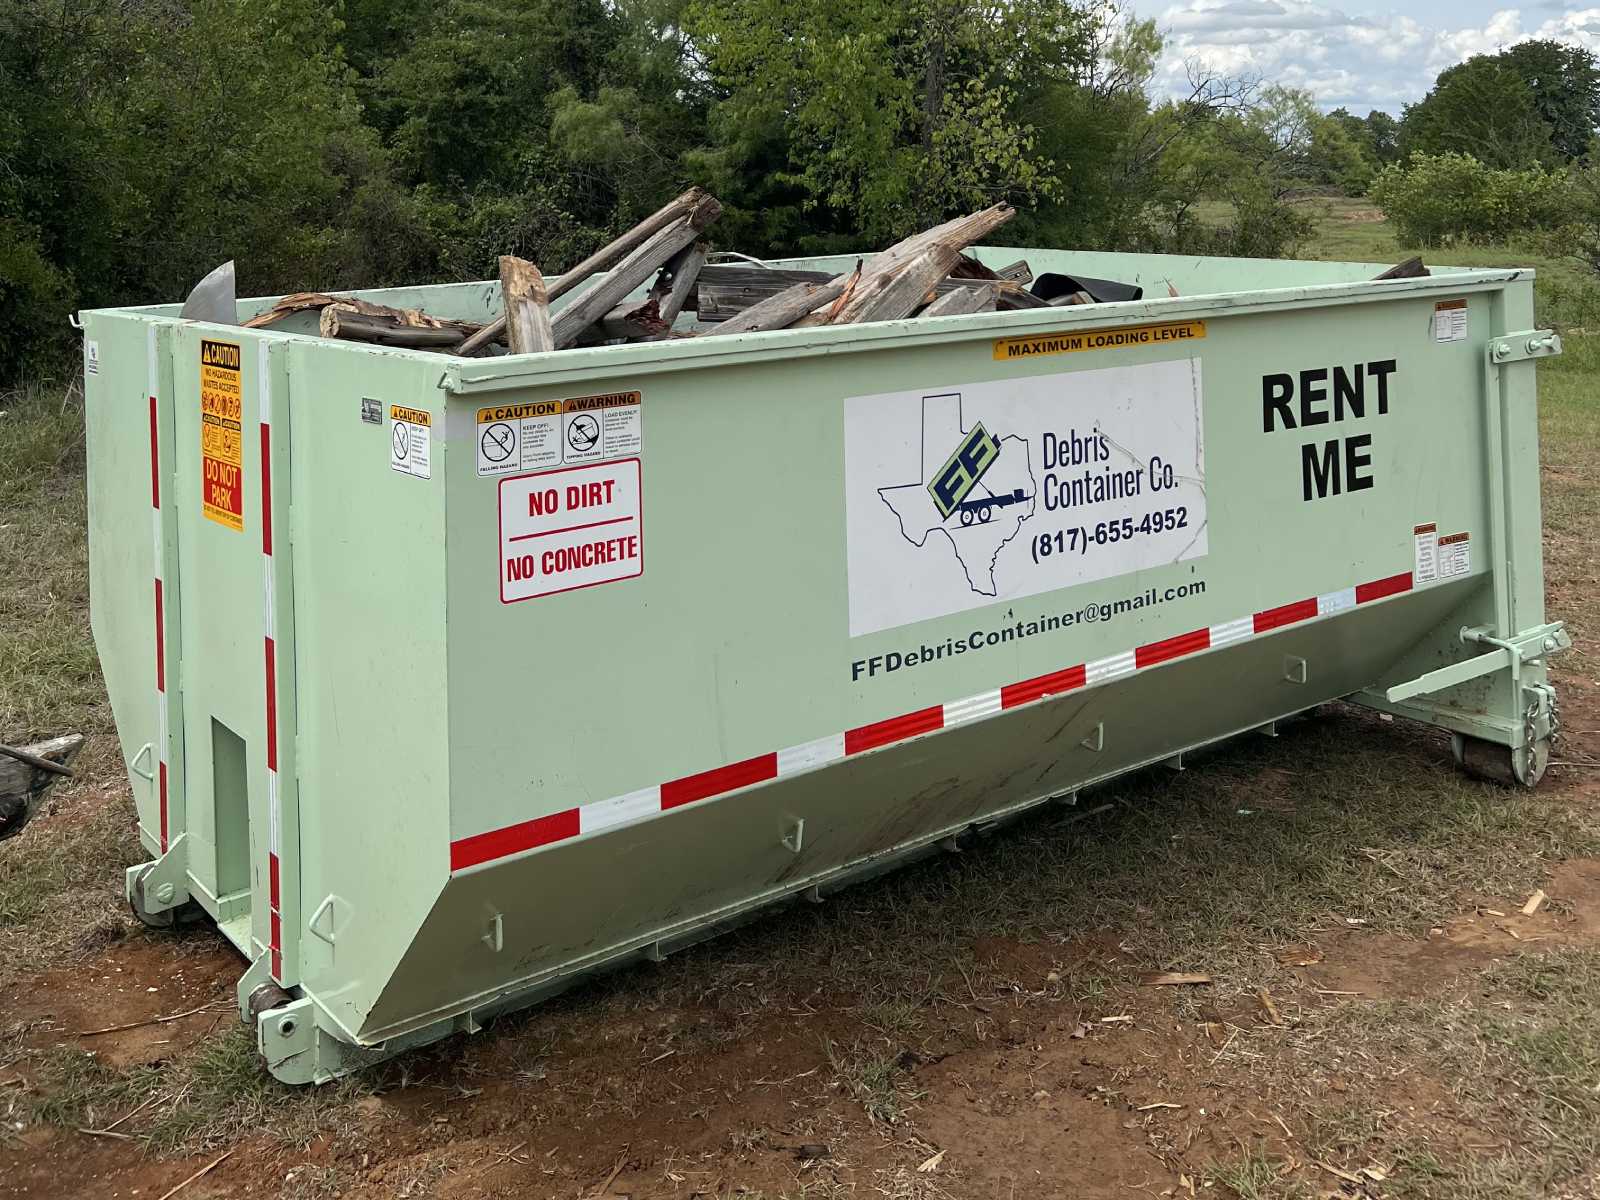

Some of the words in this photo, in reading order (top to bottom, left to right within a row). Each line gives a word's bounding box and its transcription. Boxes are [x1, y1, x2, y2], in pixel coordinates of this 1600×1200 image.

[211, 344, 239, 367] CAUTION
[1008, 338, 1082, 357] MAXIMUM
[1087, 332, 1149, 349] LOADING
[1153, 327, 1194, 343] LEVEL
[495, 403, 555, 419] CAUTION
[577, 393, 636, 409] WARNING
[1262, 359, 1397, 433] RENT
[399, 409, 428, 424] CAUTION
[1043, 428, 1110, 470] Debris
[1301, 433, 1374, 501] ME
[206, 458, 218, 482] DO
[219, 463, 238, 488] NOT
[933, 428, 989, 512] FF
[1044, 466, 1142, 511] Container
[1149, 456, 1179, 492] Co.
[211, 484, 233, 511] PARK
[529, 488, 558, 517] NO
[566, 480, 615, 511] DIRT
[1031, 506, 1188, 564] (817)-655-4952
[507, 554, 534, 582] NO
[541, 535, 638, 576] CONCRETE
[851, 579, 1207, 682] FFDebrisContainer@gmail.com
